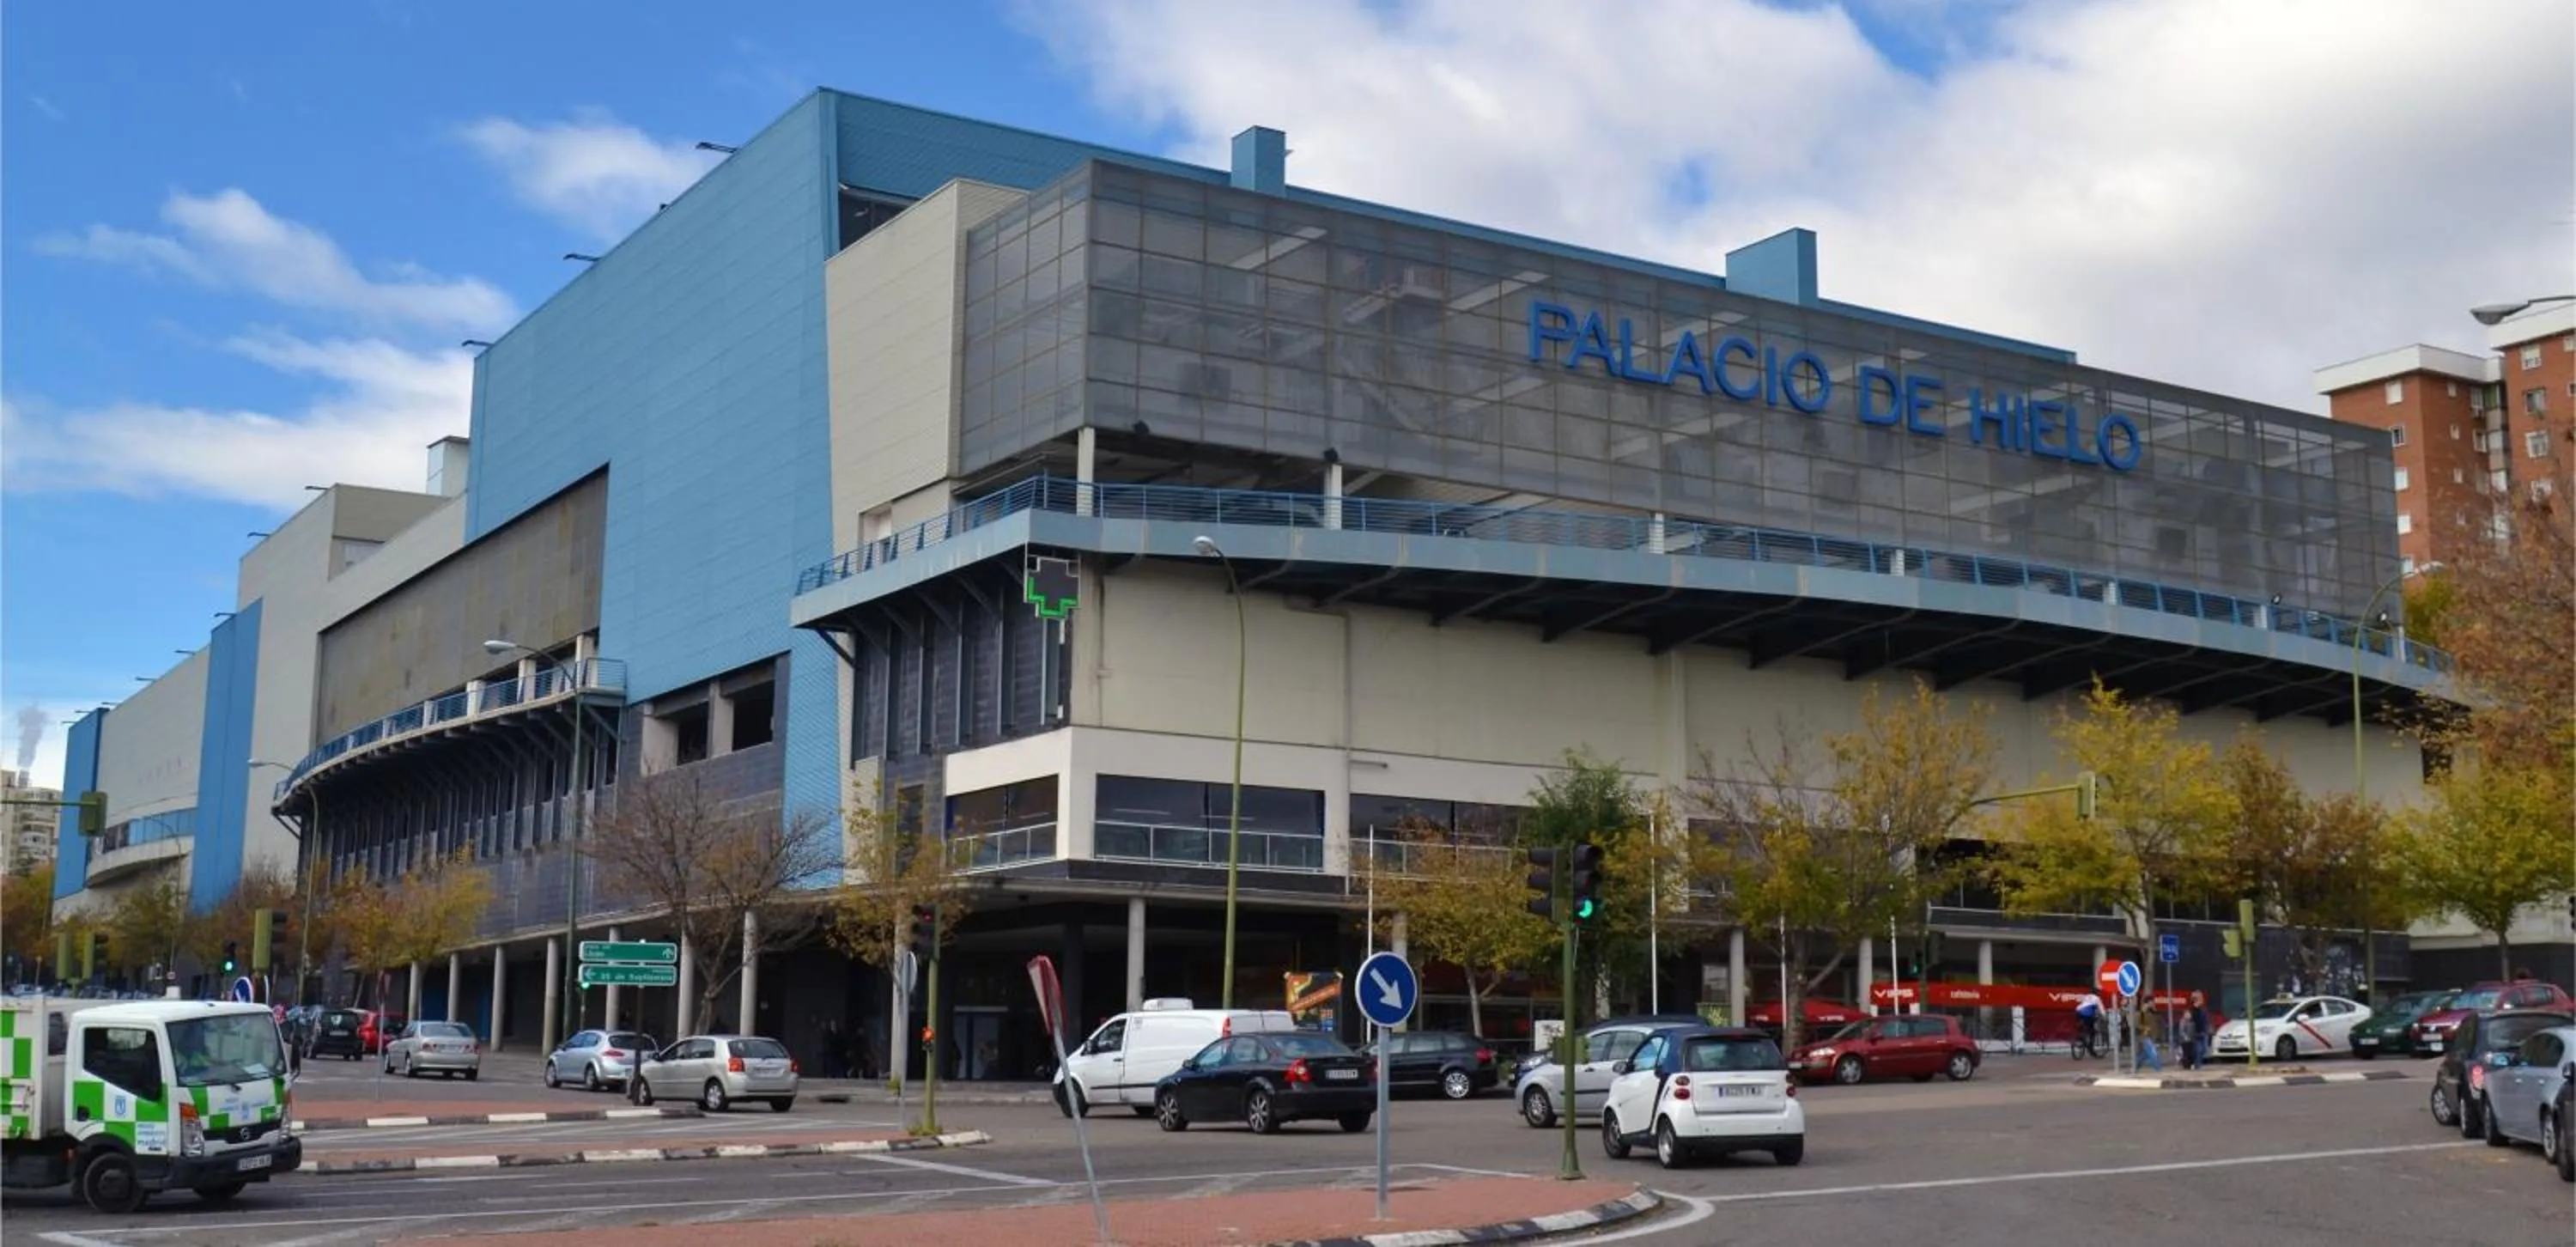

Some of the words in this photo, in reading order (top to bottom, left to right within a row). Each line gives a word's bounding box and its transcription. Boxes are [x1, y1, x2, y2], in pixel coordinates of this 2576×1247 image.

[1529, 301, 1831, 413] PALACIO
[1861, 366, 1946, 435] DE
[1971, 388, 2142, 470] HIELO
